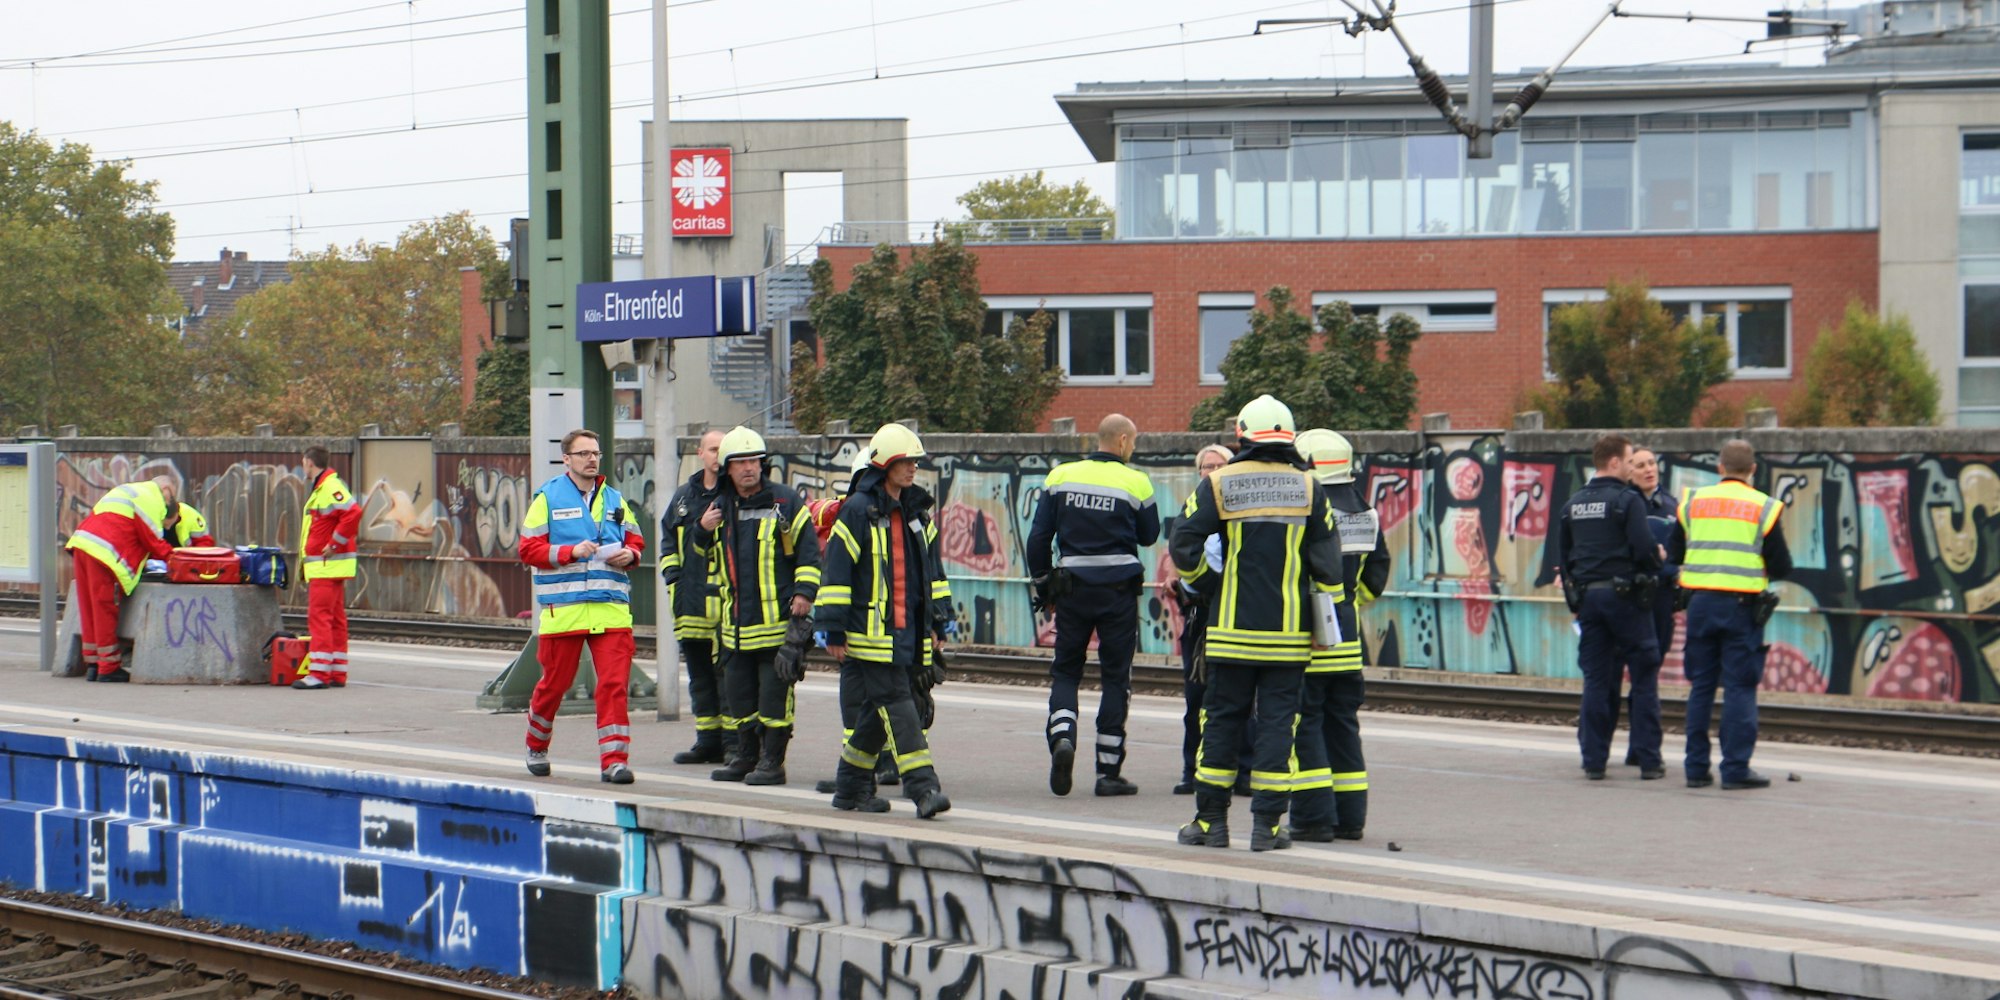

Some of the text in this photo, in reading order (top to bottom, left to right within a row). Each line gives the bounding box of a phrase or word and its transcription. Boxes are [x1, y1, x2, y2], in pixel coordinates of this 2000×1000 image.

[672, 214, 726, 230] caritas
[584, 288, 683, 323] Köln-Ehrenfeld
[1228, 476, 1299, 490] EINSATZLEITER
[1065, 492, 1116, 512] POLIZEI
[1224, 490, 1306, 507] BERUFSFEUERWEHR
[1570, 501, 1607, 515] POLIZEI
[1695, 498, 1757, 521] POLIZEI
